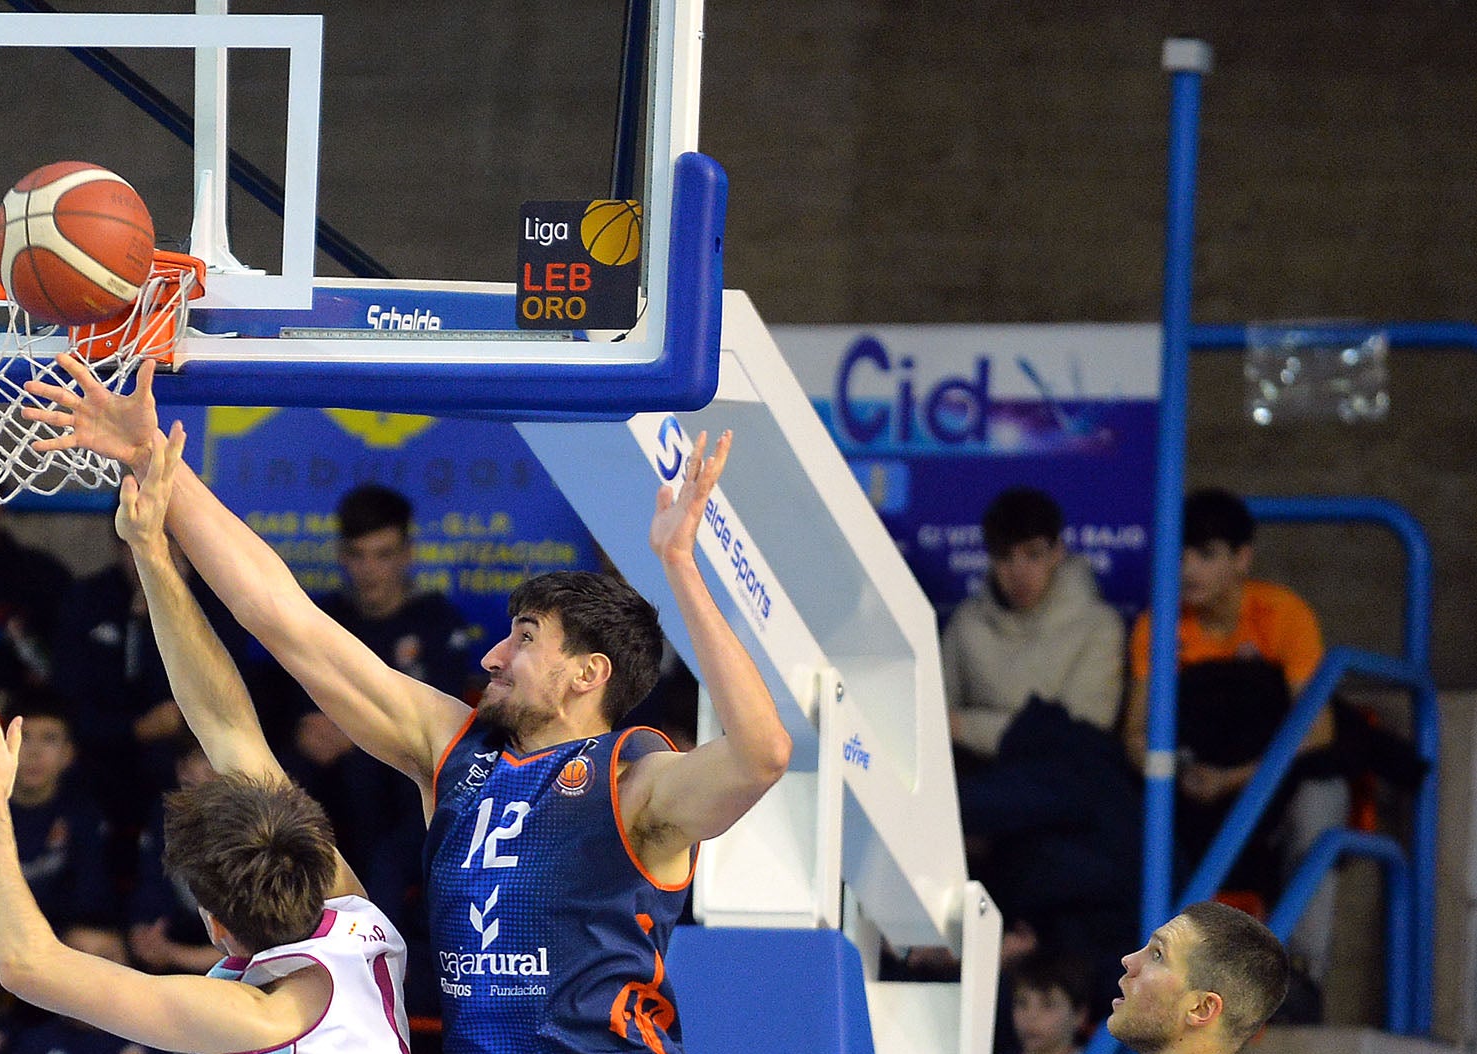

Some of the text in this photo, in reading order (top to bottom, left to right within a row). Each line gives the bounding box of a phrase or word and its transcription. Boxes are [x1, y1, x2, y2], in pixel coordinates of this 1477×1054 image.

[524, 217, 568, 246] Liga
[524, 262, 592, 292] LEB
[366, 304, 441, 330] Schelde
[523, 296, 587, 320] ORO
[834, 334, 990, 445] Cid
[730, 538, 772, 620] Sports
[461, 797, 532, 869] 12
[490, 985, 547, 996] Fundación
